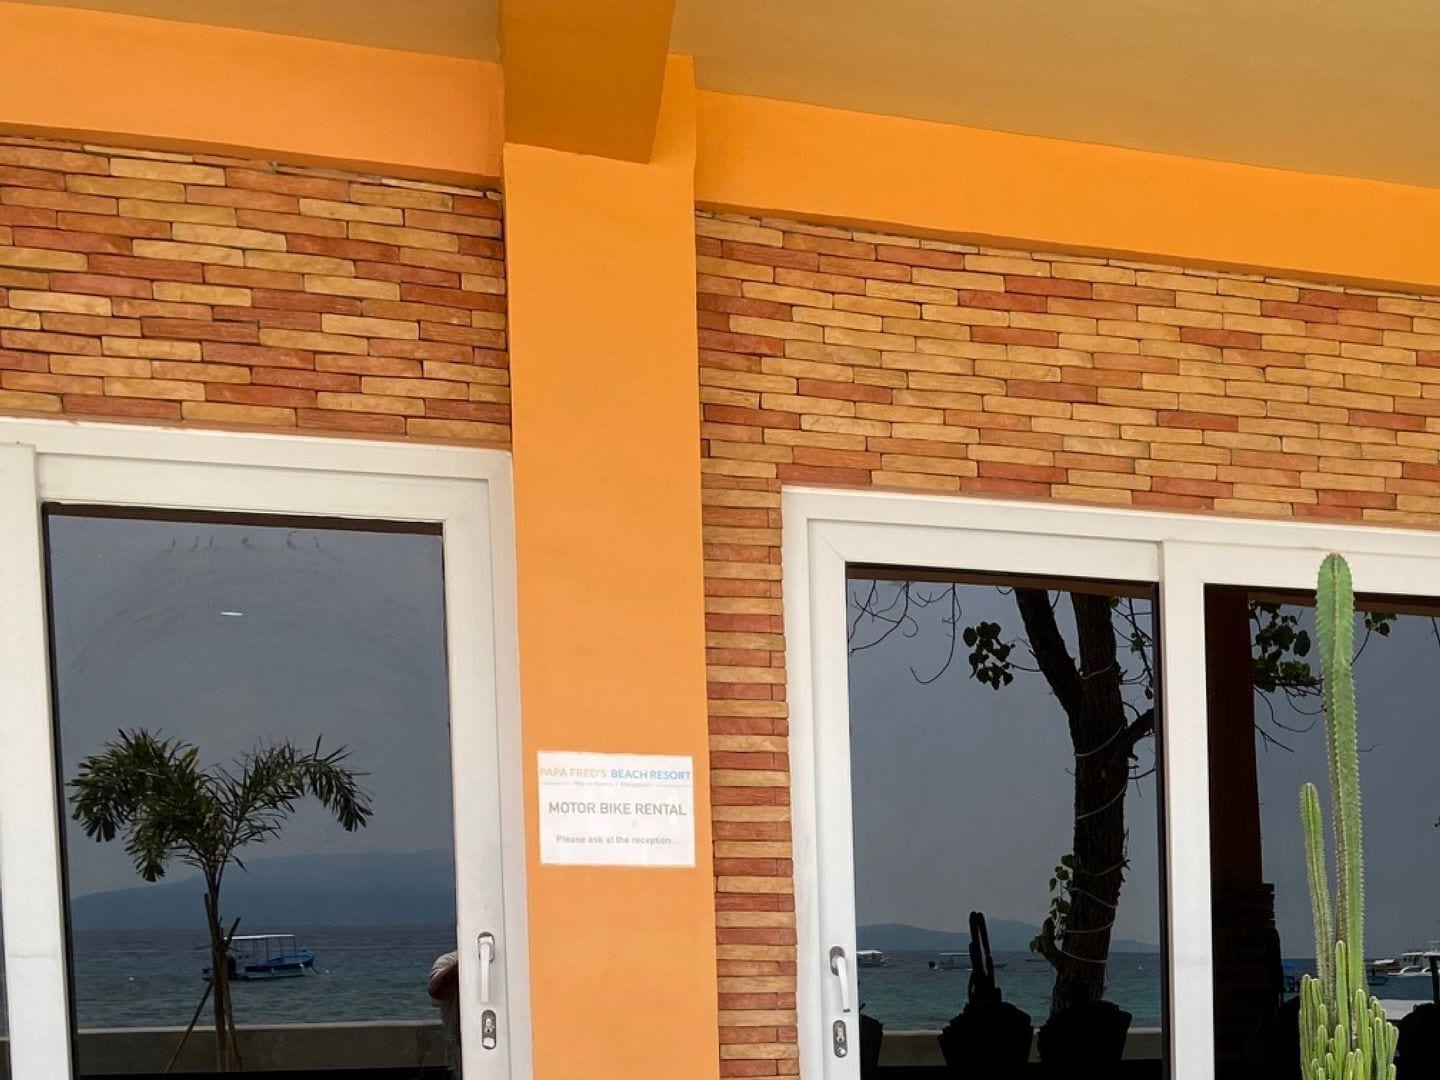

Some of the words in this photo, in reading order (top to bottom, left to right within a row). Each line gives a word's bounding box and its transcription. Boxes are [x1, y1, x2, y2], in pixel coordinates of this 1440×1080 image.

[539, 767, 568, 778] PAPA
[569, 767, 607, 779] FRED'S
[611, 768, 648, 780] BEACH
[650, 770, 690, 781] RESORT
[548, 802, 596, 814] MOTOR
[600, 802, 632, 815] BIKE
[635, 803, 687, 816] RENTAL
[556, 835, 586, 844] Please
[588, 835, 603, 844] ask
[606, 836, 615, 844] at
[616, 836, 630, 845] the
